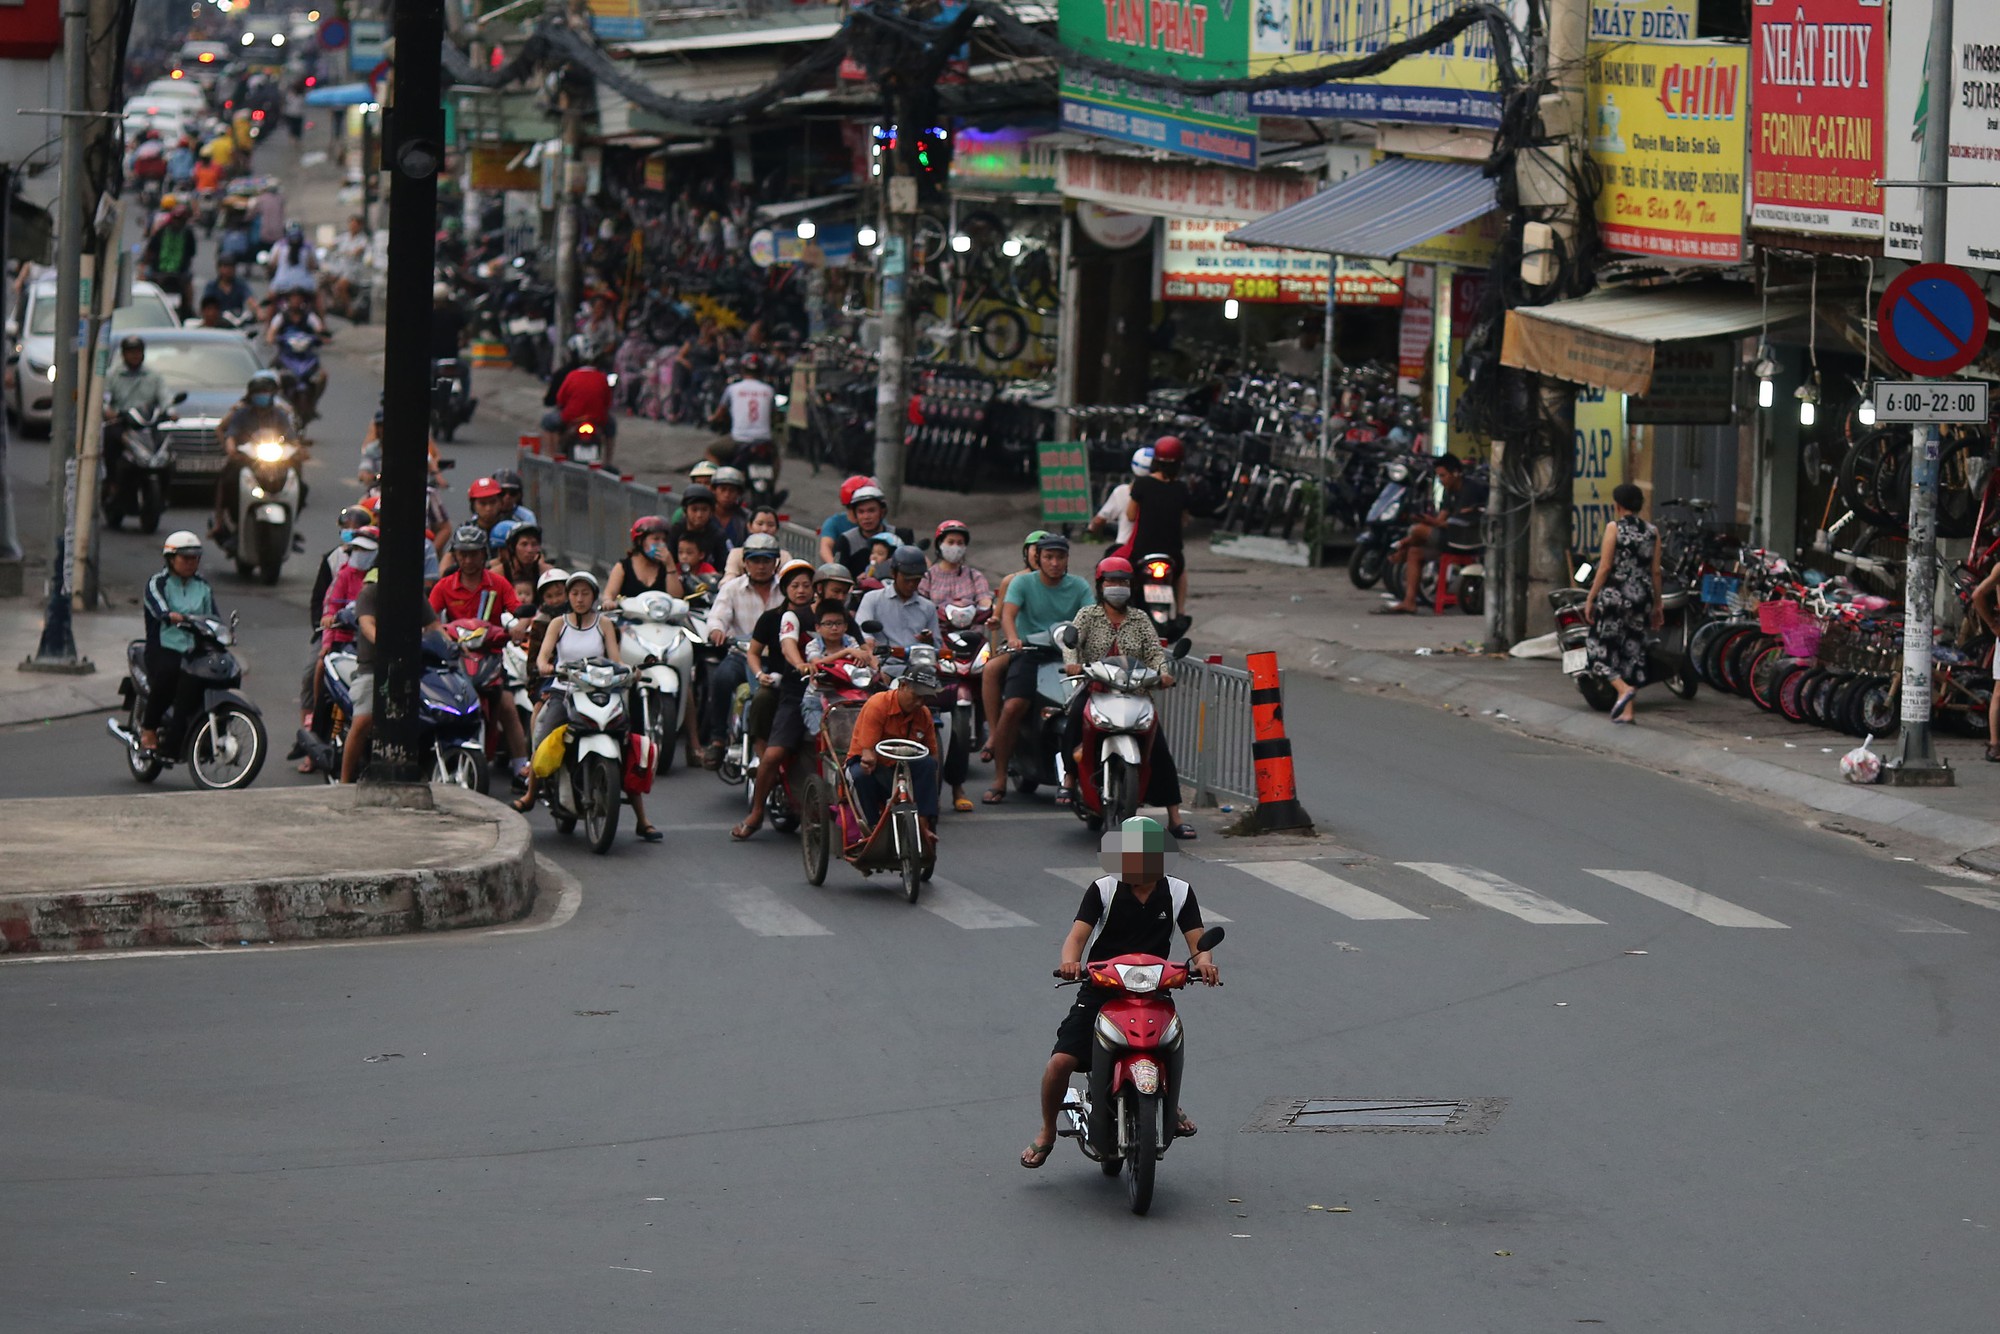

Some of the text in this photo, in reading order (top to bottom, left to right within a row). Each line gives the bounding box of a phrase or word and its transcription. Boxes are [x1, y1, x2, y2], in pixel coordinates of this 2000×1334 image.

[1592, 2, 1635, 37] MÁY
[1761, 5, 1872, 104] NHẬT HUY
[1661, 57, 1739, 120] CHÍN
[1761, 112, 1872, 161] FORNIX-CATANI
[1887, 393, 1975, 411] 6:00-22:00
